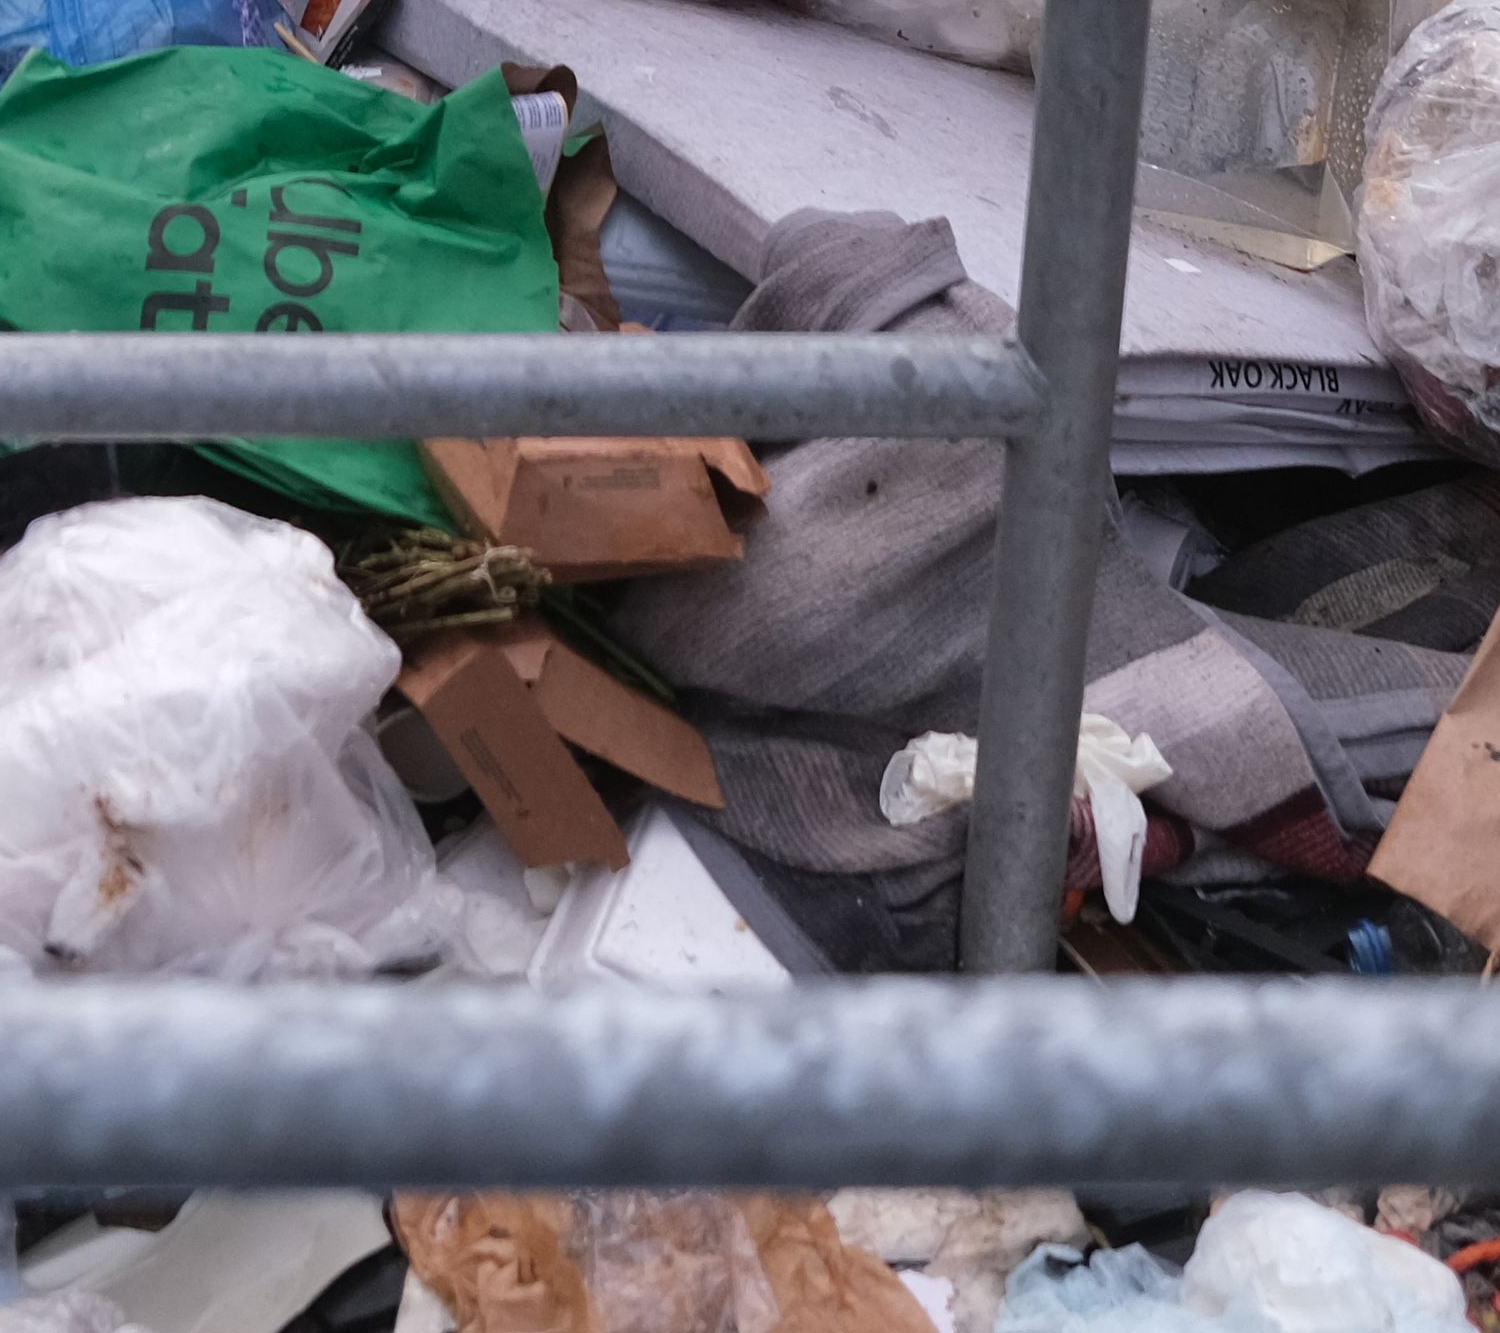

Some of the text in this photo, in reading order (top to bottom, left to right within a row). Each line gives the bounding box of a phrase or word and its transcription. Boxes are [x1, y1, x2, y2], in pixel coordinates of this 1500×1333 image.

[255, 177, 362, 332] Ube
[1208, 359, 1340, 393] BLACK OAK
